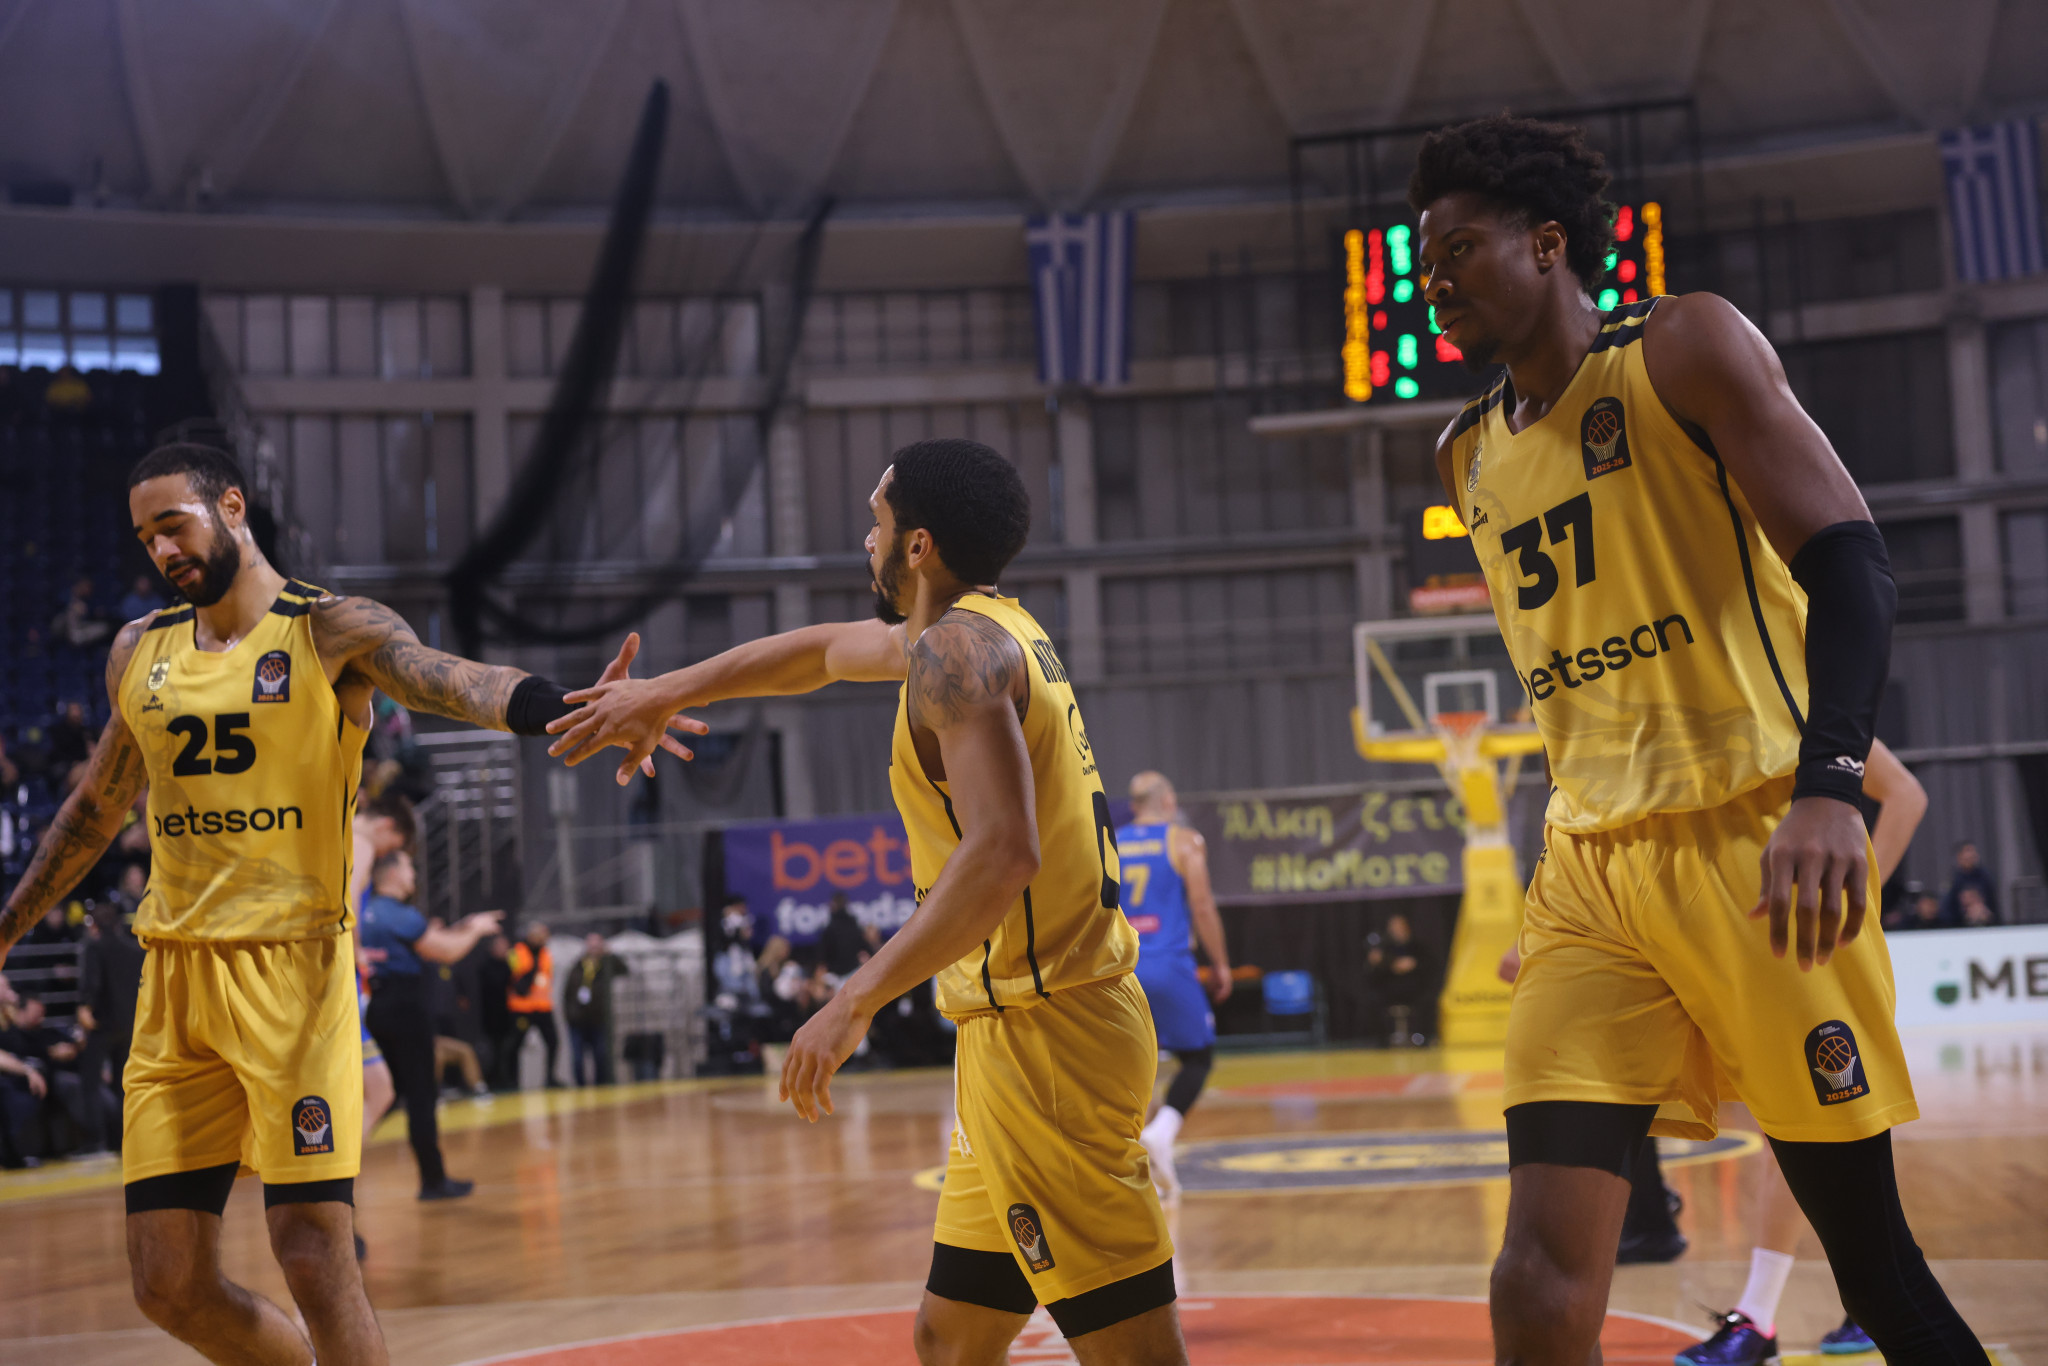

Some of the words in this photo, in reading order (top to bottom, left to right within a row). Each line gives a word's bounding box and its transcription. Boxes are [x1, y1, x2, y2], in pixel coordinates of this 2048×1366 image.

[1592, 457, 1624, 475] 2025-26
[1501, 491, 1596, 610] 37
[1519, 614, 1695, 708] etsson
[166, 712, 256, 777] 25
[770, 829, 913, 892] bet
[1122, 863, 1150, 908] 7
[1826, 1085, 1863, 1102] 2025-26
